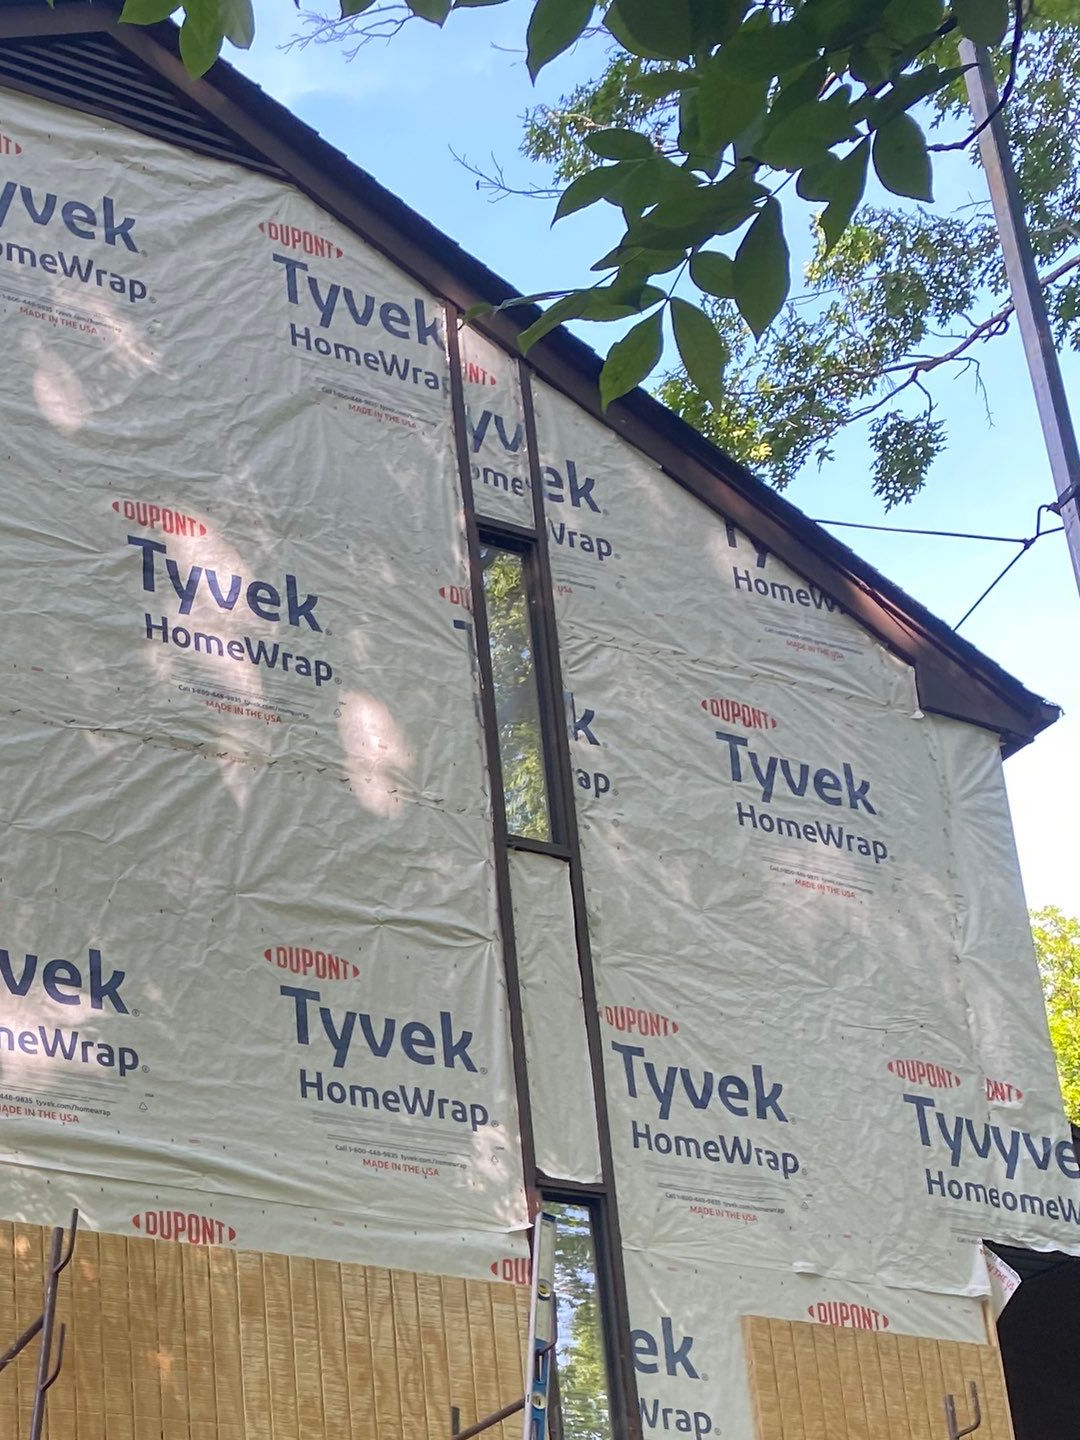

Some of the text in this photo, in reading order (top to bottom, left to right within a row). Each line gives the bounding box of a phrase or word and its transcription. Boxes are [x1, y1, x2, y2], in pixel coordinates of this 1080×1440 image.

[268, 222, 334, 259] DUPONT
[272, 252, 446, 352] Tyvek
[123, 500, 197, 537] DUPONT
[127, 535, 323, 633] Tyvek
[144, 612, 333, 687] HomeWrap
[710, 699, 769, 730] DUPONT
[715, 731, 877, 815] Tyvek
[736, 801, 888, 864] HomeWrap
[276, 946, 350, 981] DUPONT
[279, 984, 479, 1073] Tyvek
[605, 1005, 670, 1037] DUPONT
[611, 1040, 789, 1123] Tyvek
[896, 1059, 953, 1089] DUPONT
[24, 1107, 36, 1117] IN
[37, 1109, 57, 1121] THE
[59, 1113, 80, 1124] USA
[299, 1068, 489, 1133] HomeWrap
[362, 1158, 440, 1177] MADE IN THE USA
[631, 1120, 799, 1180] HomeWrap
[145, 1210, 226, 1244] DUPONT
[689, 1205, 758, 1223] MADE IN THE USA
[816, 1301, 881, 1331] DUPONT
